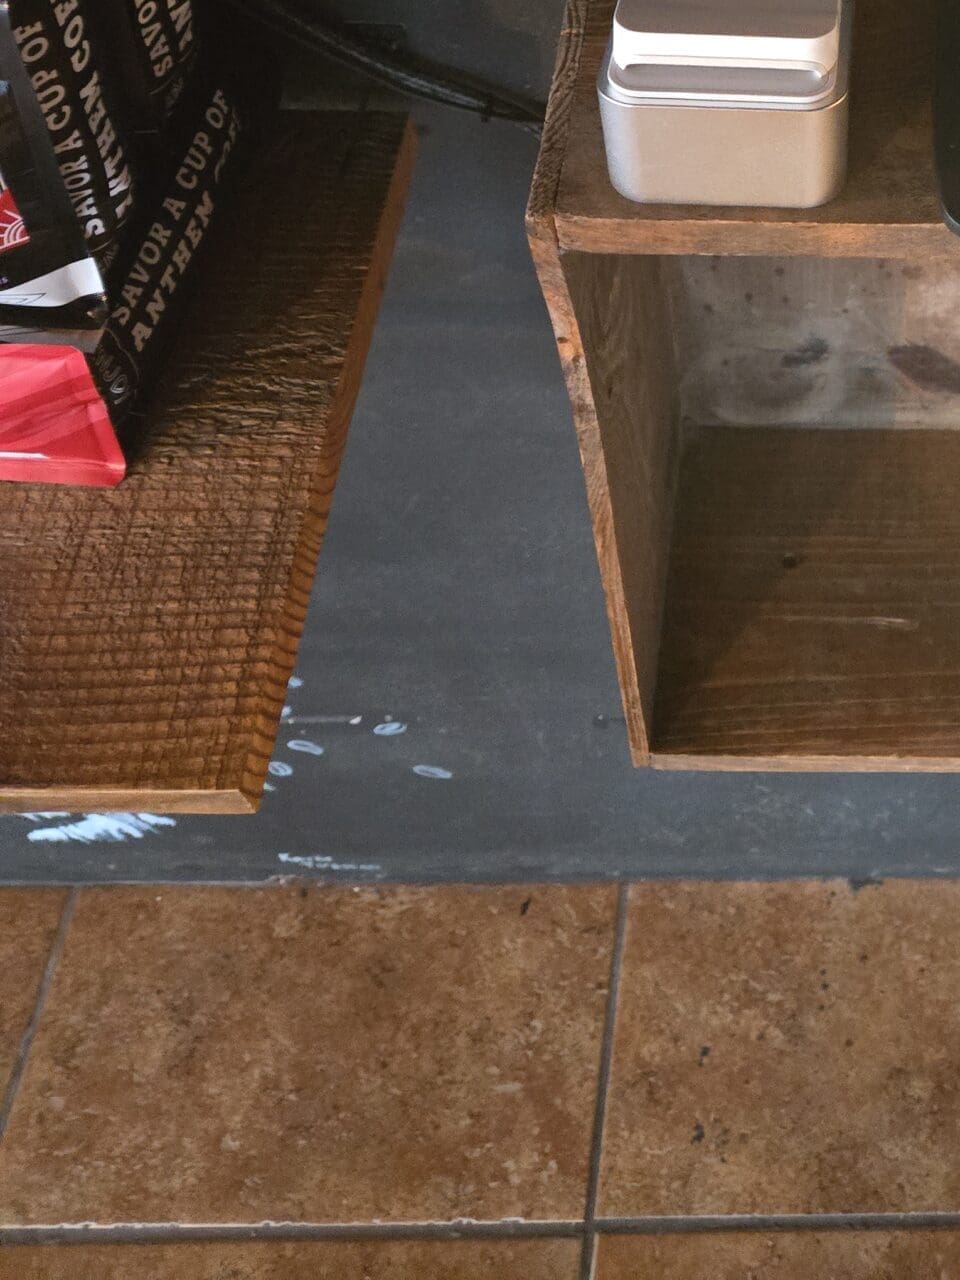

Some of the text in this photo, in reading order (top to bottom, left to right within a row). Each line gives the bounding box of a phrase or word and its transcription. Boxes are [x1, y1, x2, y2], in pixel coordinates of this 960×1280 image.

[13, 21, 106, 239] SAVOR A CUP OF
[162, 197, 187, 221] A
[175, 131, 213, 190] CUP
[205, 88, 229, 129] OF
[131, 190, 214, 353] ANTHEM
